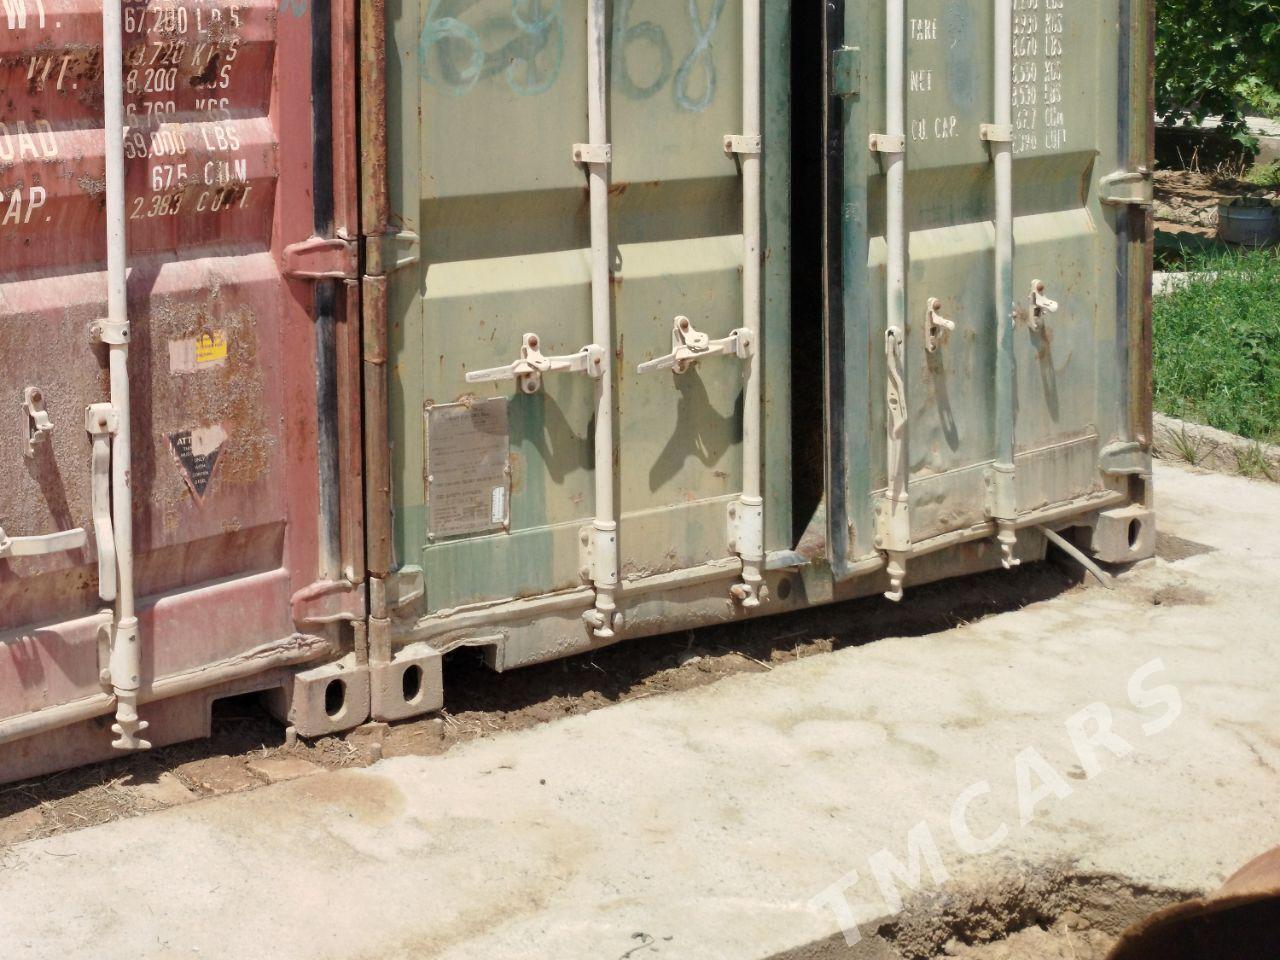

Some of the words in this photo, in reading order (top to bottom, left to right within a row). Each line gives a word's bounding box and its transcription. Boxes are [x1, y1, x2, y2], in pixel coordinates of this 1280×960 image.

[126, 68, 178, 95] 8,200
[124, 100, 176, 129] 6,760
[201, 126, 240, 152] LBS
